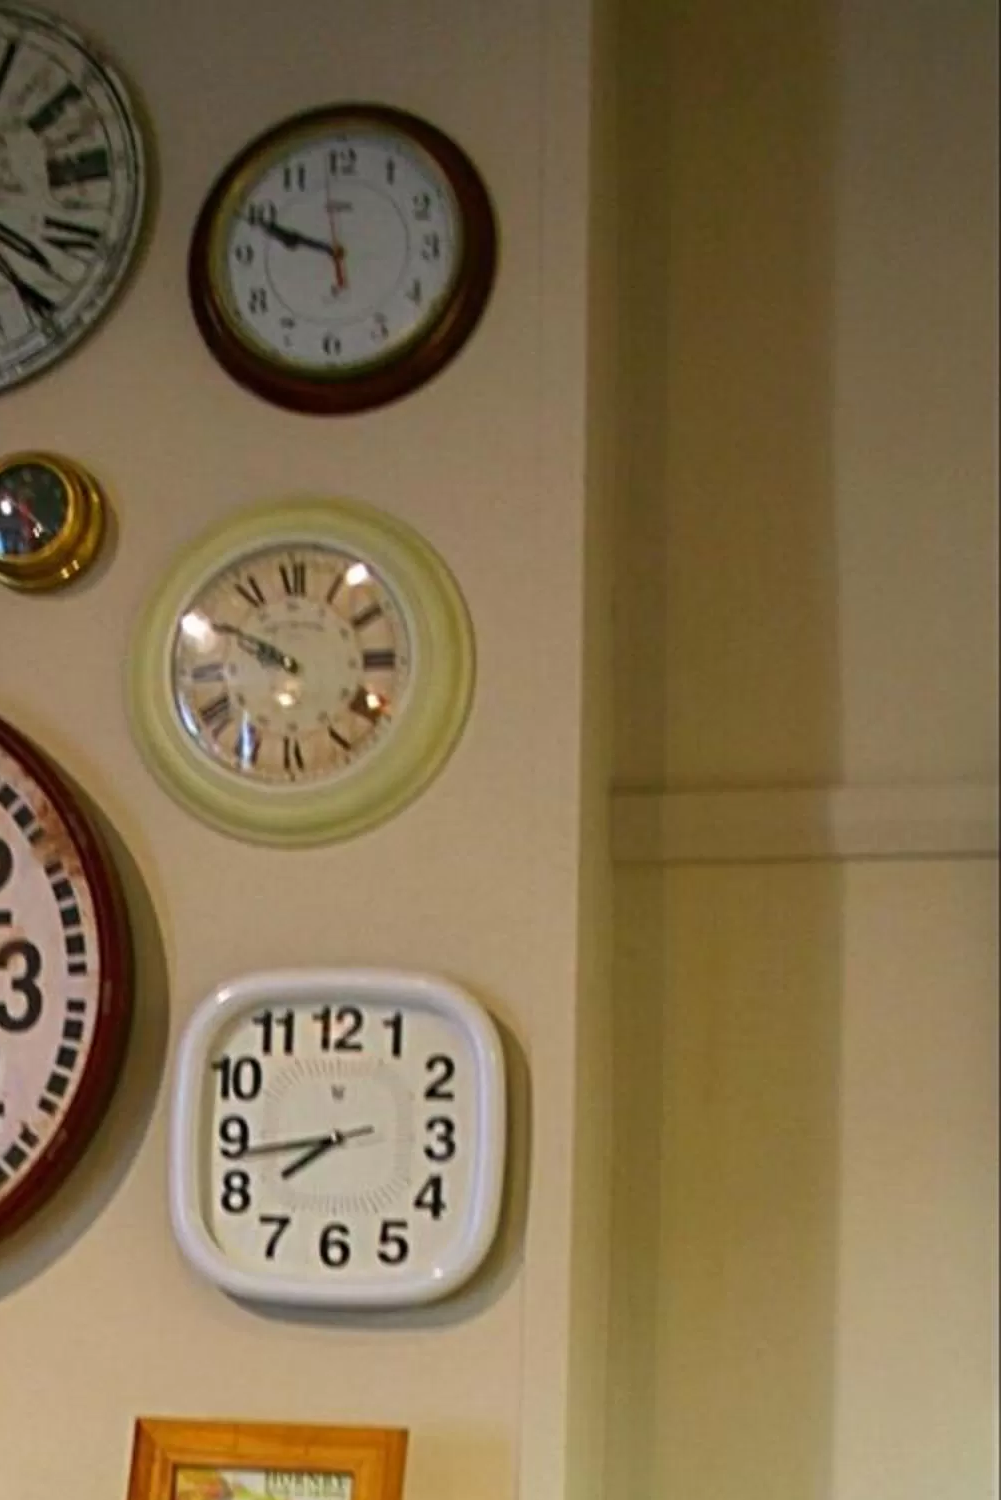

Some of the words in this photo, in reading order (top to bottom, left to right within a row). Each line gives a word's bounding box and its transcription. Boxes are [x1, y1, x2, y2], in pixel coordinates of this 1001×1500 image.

[252, 1008, 295, 1056] 11
[311, 1004, 364, 1052] 12
[382, 1011, 404, 1059] 1
[210, 1054, 263, 1102] 10
[423, 1054, 456, 1101] 2
[219, 1115, 250, 1161] 9
[423, 1116, 456, 1162] 3
[220, 1170, 252, 1214] 8
[412, 1174, 447, 1220] 4
[258, 1215, 292, 1260] 7
[318, 1222, 351, 1268] 6
[376, 1220, 409, 1265] 5
